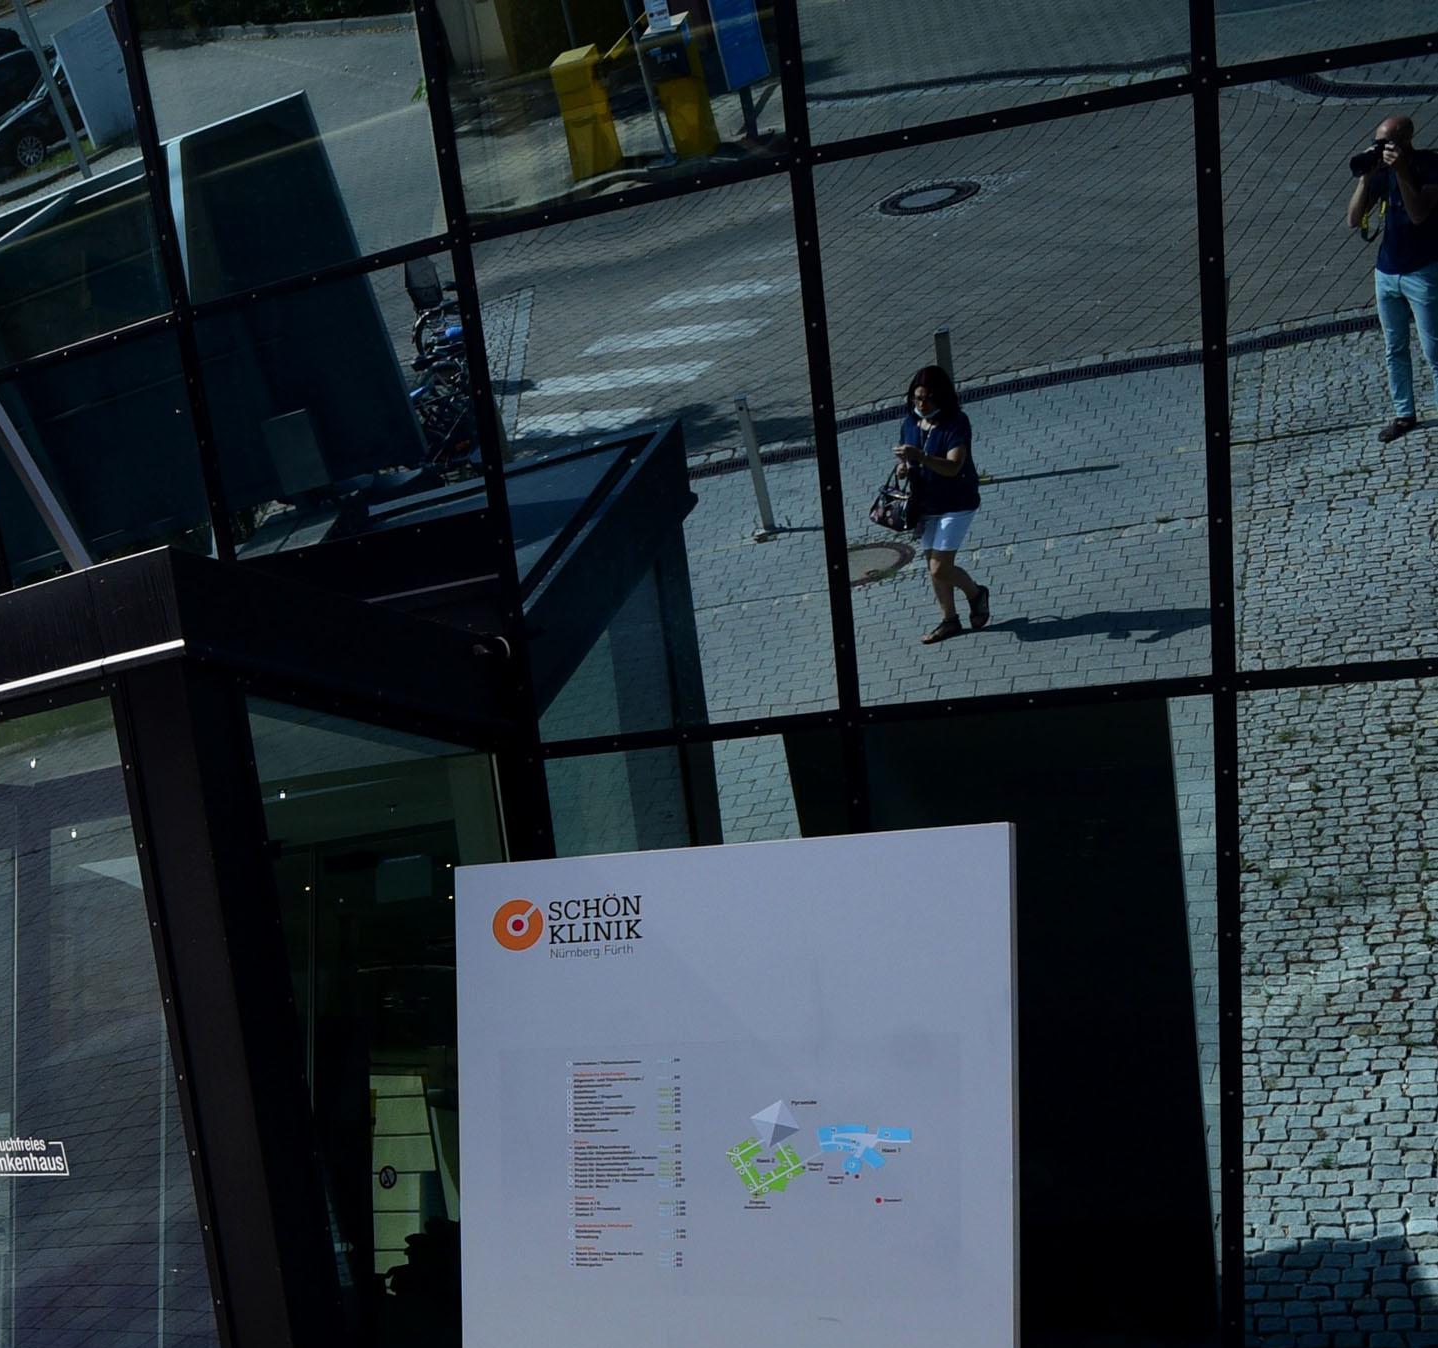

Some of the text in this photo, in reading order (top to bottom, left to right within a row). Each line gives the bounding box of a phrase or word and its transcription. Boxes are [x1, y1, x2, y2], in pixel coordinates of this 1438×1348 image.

[548, 893, 642, 921] SCHÖN
[548, 919, 643, 945] KLINIK
[550, 944, 634, 959] Nürnberg Fürth
